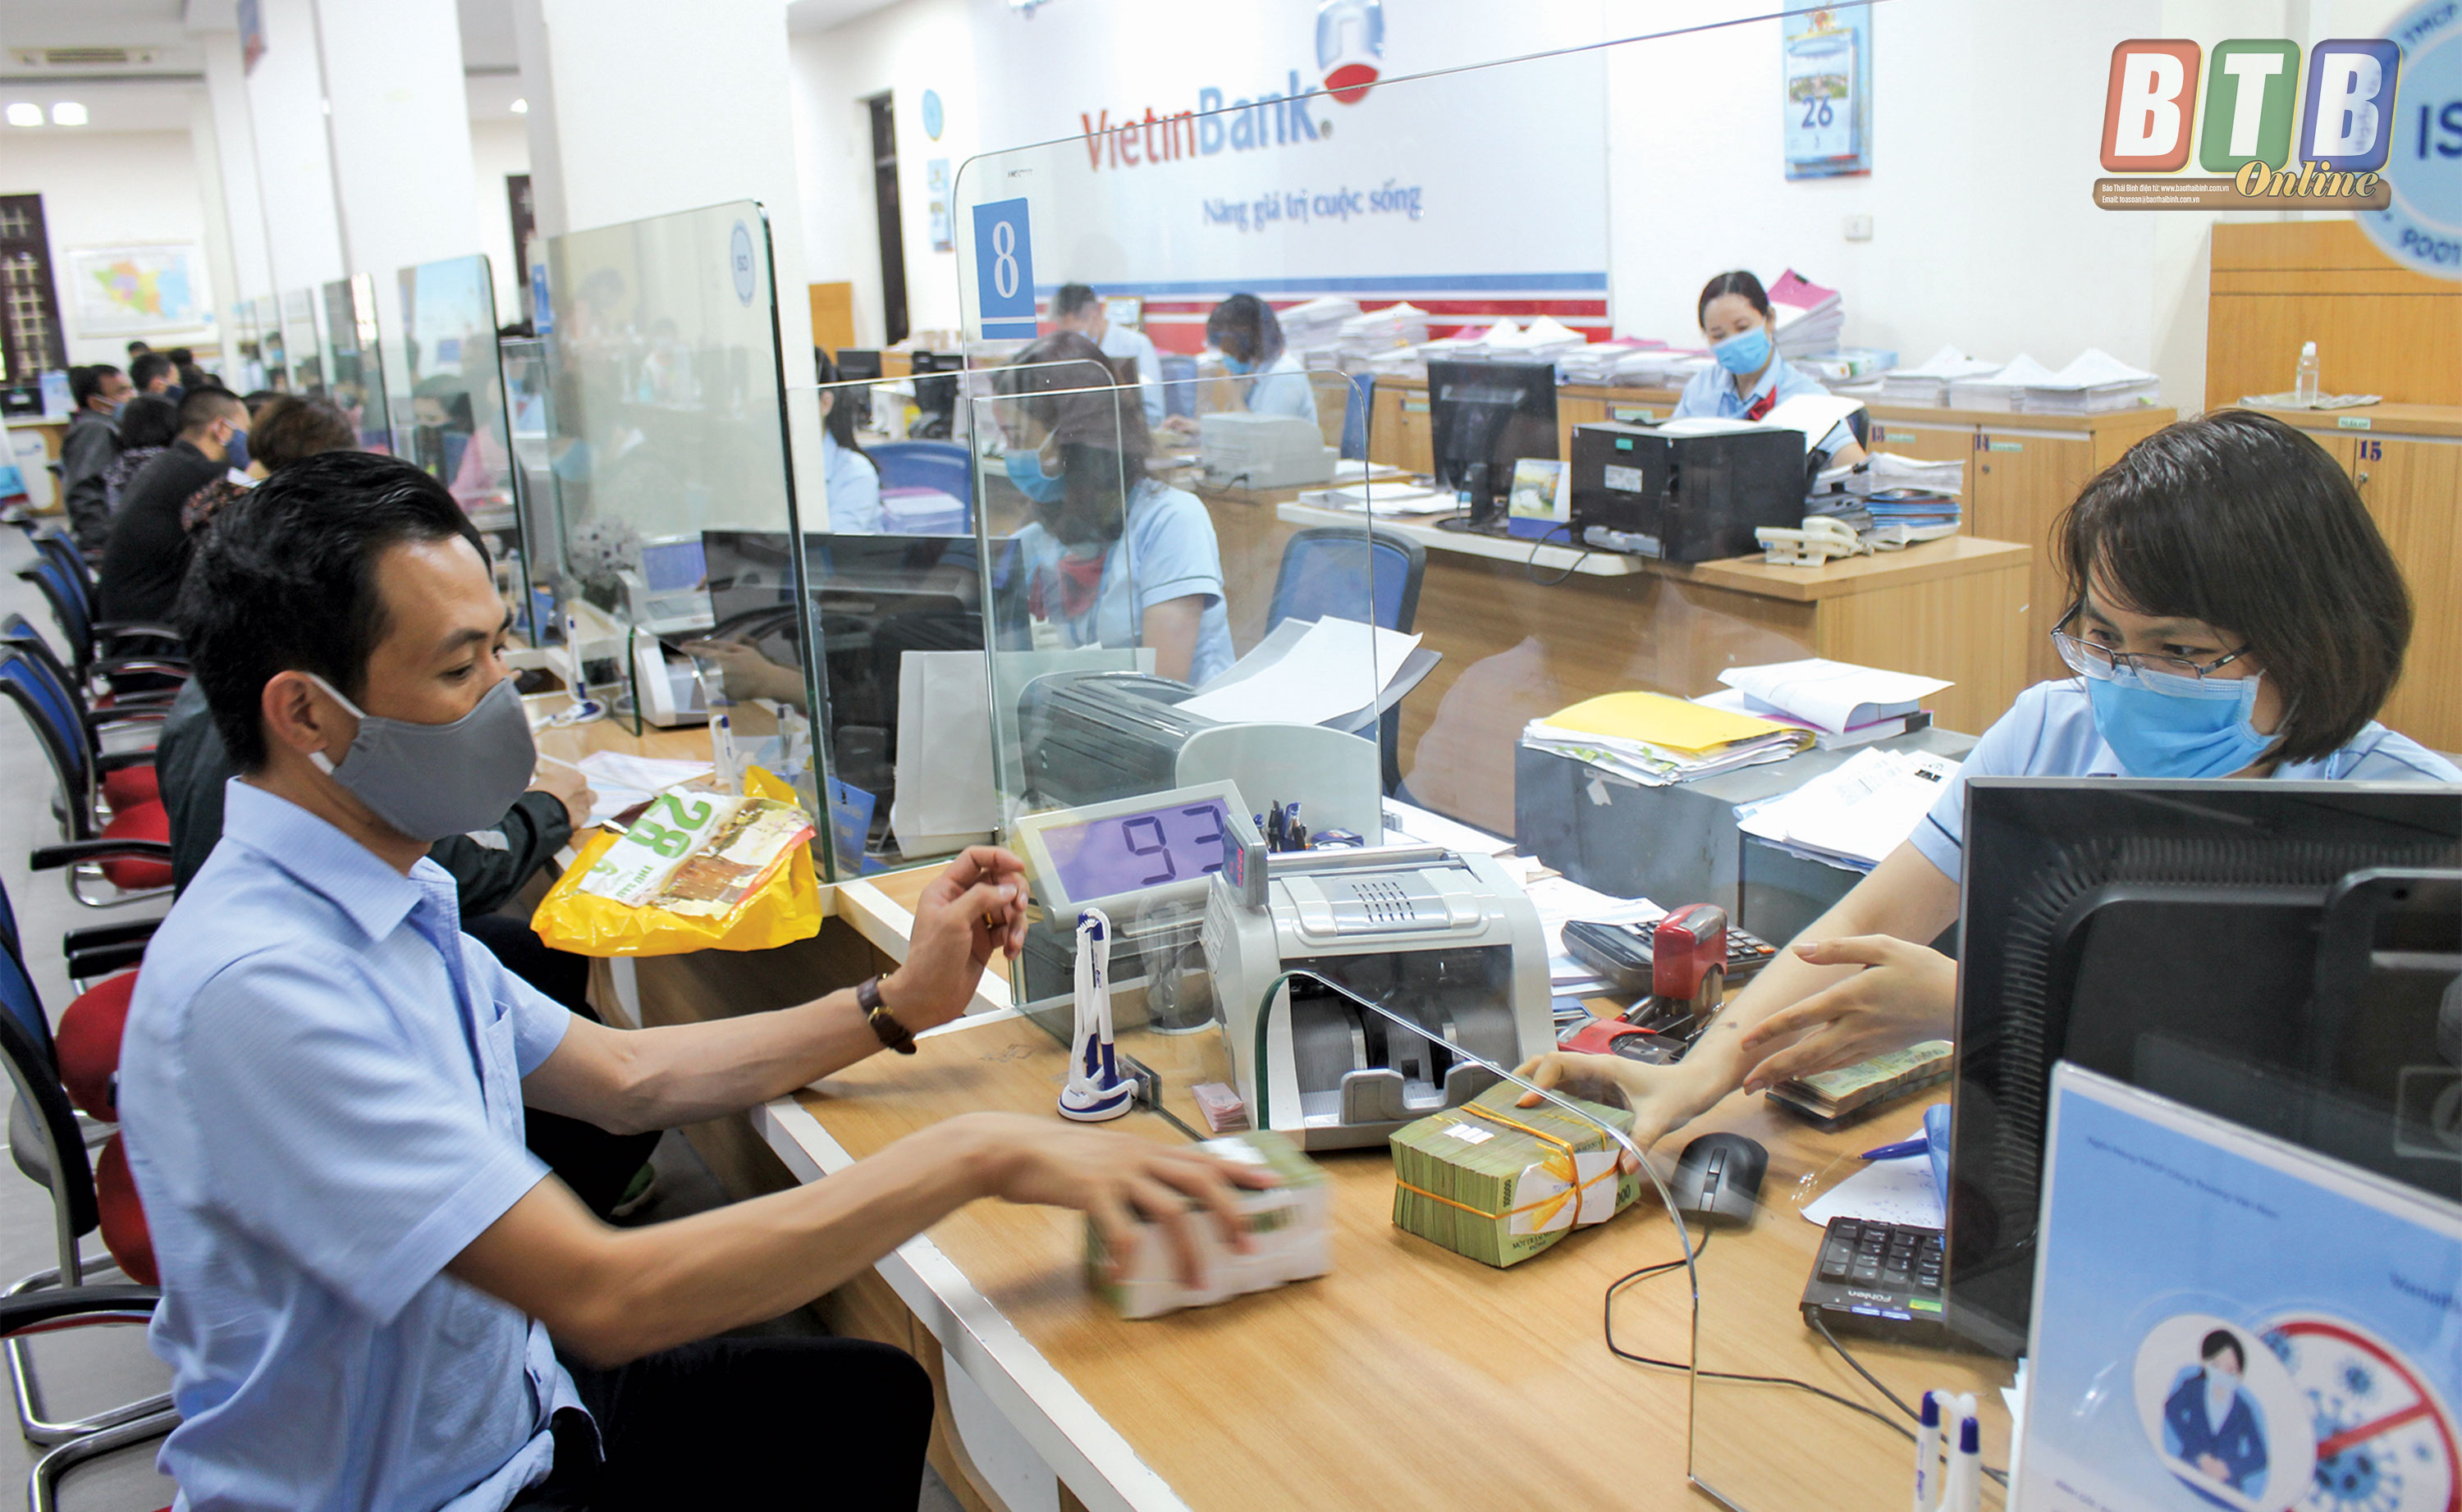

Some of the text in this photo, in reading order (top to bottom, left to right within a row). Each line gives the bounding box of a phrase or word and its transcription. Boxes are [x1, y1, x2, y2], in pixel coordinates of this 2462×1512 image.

[1081, 70, 1320, 171] VietinBank
[1801, 94, 1834, 129] 26
[993, 221, 1019, 299] 8
[2359, 440, 2382, 462] 15
[626, 793, 712, 859] 28
